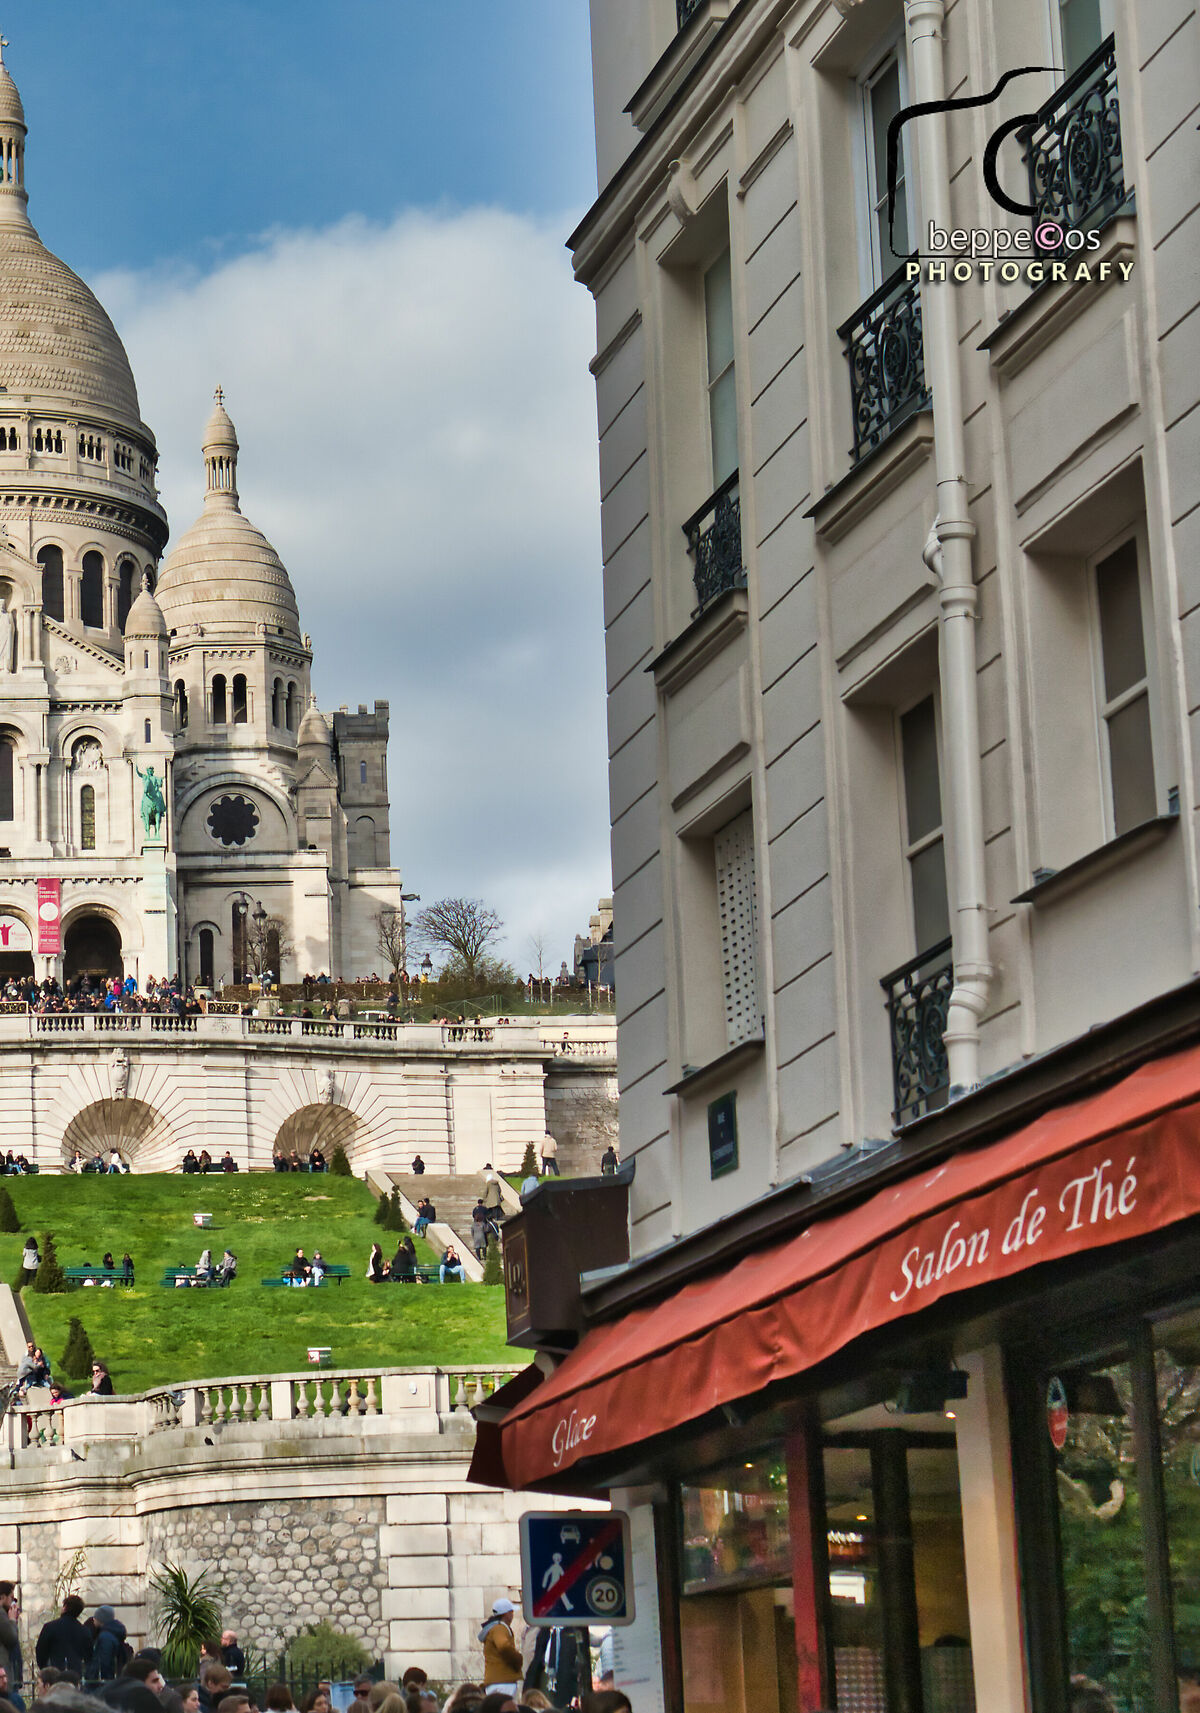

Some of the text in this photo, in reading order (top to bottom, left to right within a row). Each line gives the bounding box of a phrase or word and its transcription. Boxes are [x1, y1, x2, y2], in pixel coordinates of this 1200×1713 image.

[890, 1156, 1137, 1302] Salon de Thé
[552, 1409, 597, 1468] Glace
[595, 1588, 615, 1602] 20
